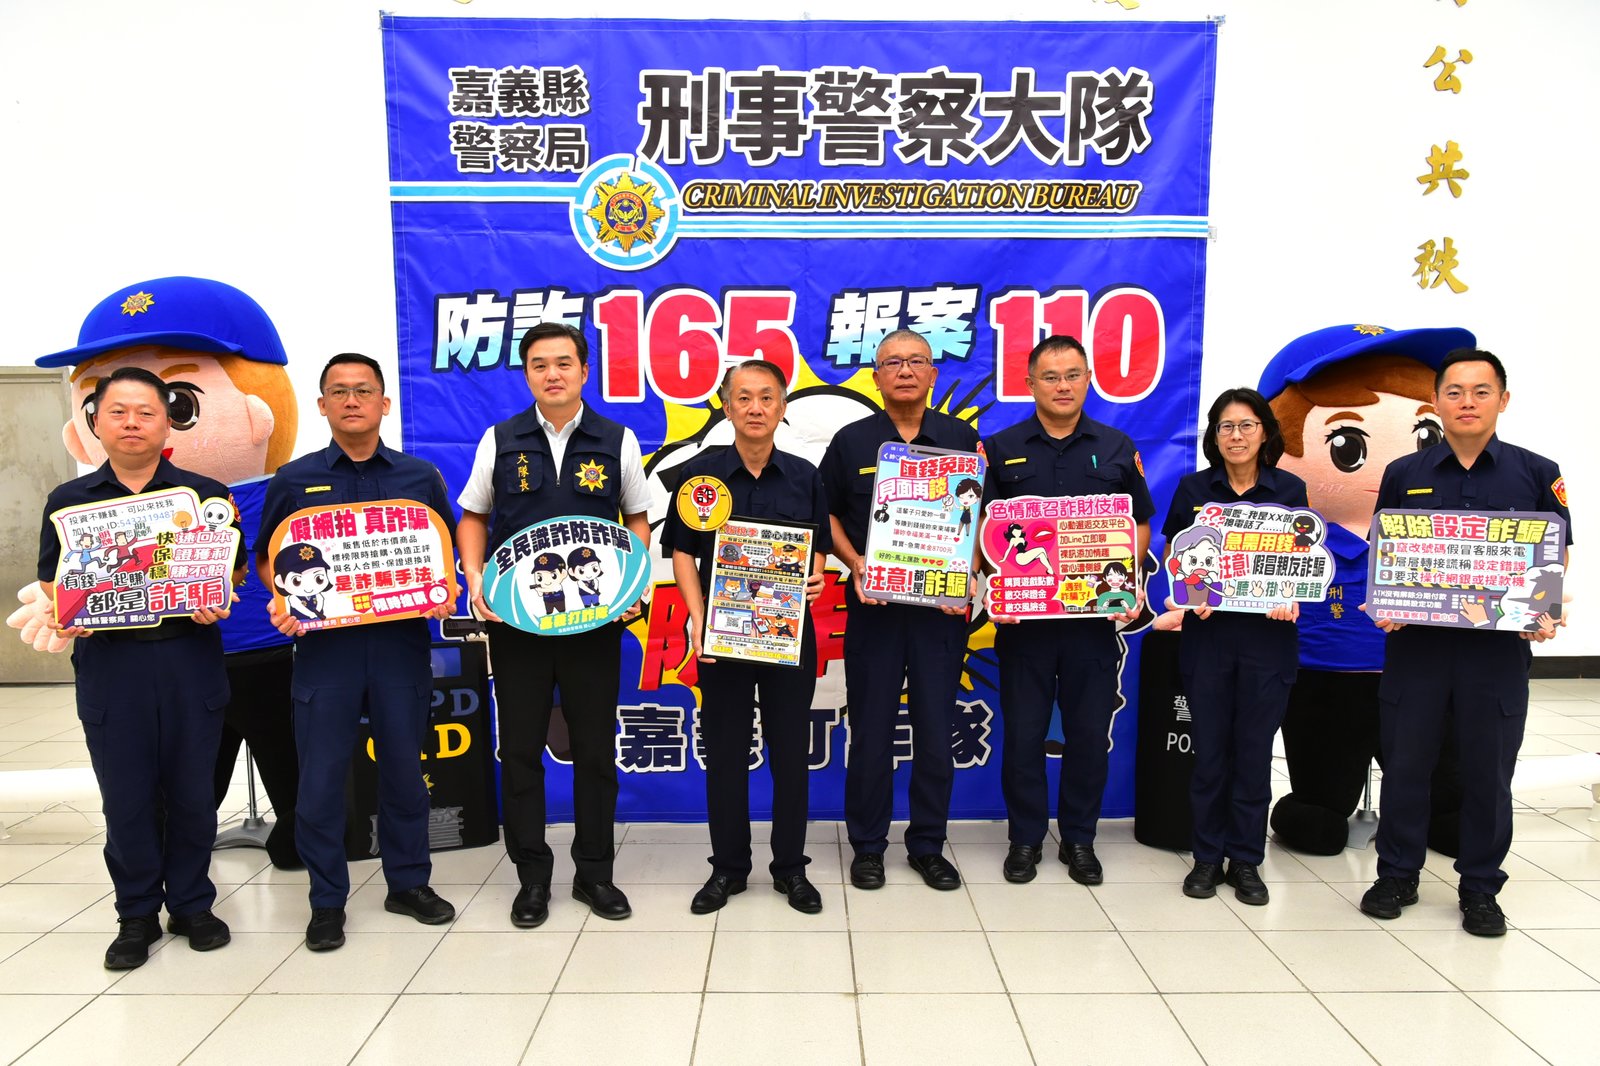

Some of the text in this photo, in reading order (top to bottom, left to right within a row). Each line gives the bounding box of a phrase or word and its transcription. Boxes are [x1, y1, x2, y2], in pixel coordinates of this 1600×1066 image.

[450, 67, 588, 114] 嘉義縣
[640, 69, 1150, 163] 刑事警察大隊
[451, 124, 588, 170] 警察局
[683, 183, 1138, 210] CRIMINAL INVESTIGATION BUREAU
[594, 288, 797, 403] 165
[826, 285, 978, 364] 報案
[517, 453, 530, 492] 大隊長
[900, 456, 978, 478] 匯錢免談
[878, 477, 948, 504] 見面再談
[990, 497, 1130, 520] 色情應召詐財伎倆
[155, 530, 233, 546] 快速回本
[290, 506, 430, 543] 假網拍 真詐騙
[1379, 513, 1549, 545] 解除設定詐騙
[153, 547, 230, 562] 保證獲利
[343, 535, 418, 550] 販售低於市價商品
[495, 520, 633, 577] 全民識詐防詐騙
[149, 564, 226, 581] 穩賺不賠
[335, 566, 432, 593] 是詐騙手法
[1252, 554, 1326, 578] 假冒親友詐騙
[1394, 571, 1526, 587] 要求操作網銀或提款機
[63, 571, 144, 590] 有錢一起賺
[1295, 581, 1323, 599] 查證
[87, 578, 225, 615] 都是詐騙
[1328, 586, 1345, 619] 刑警
